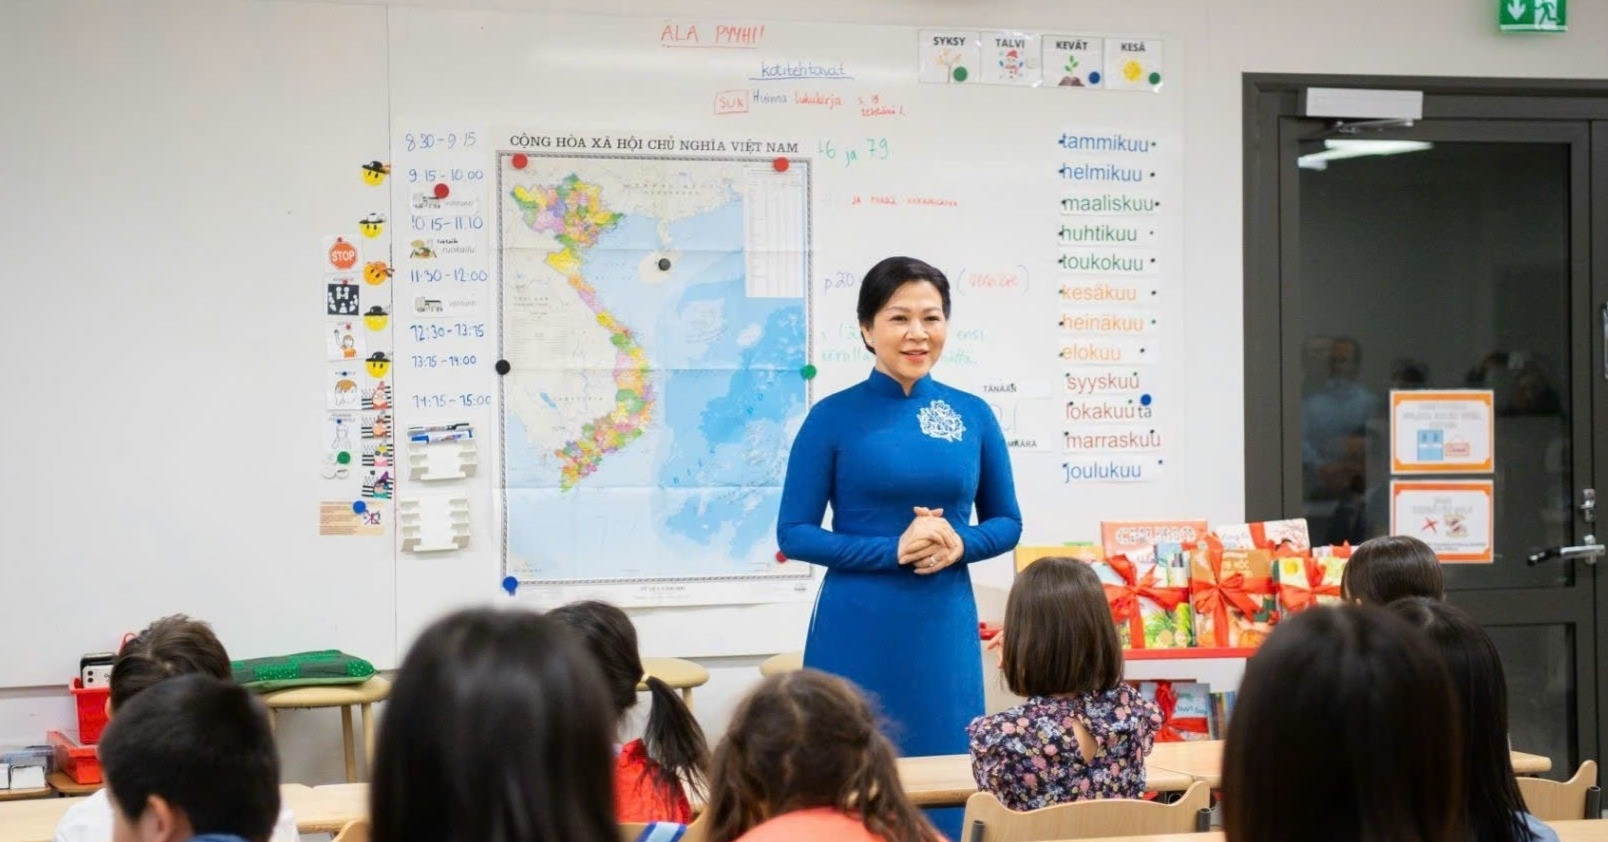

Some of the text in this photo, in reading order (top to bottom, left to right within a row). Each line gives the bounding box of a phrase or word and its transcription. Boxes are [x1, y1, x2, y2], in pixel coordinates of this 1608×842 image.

[933, 36, 966, 46] SYKSY
[995, 38, 1025, 48] TALVI
[1056, 39, 1088, 50] KEVÄT
[1121, 41, 1146, 52] KESÄ
[510, 132, 551, 149] CỘNG
[617, 135, 643, 152] HỘI
[647, 135, 675, 151] CHỦ
[680, 138, 727, 152] NGHĨA
[731, 138, 763, 155] VIỆT
[766, 142, 799, 154] NAM
[1062, 133, 1149, 152] tammikuu
[1062, 163, 1142, 181] helmikuu
[1064, 194, 1153, 211] maaliskuu
[1061, 225, 1137, 241] huhtikuu
[331, 249, 355, 262] STOP
[1062, 253, 1143, 271] toukokuu
[1062, 283, 1137, 301] kesäkuu
[1062, 313, 1143, 331] heinäkuu
[1062, 343, 1121, 360] elokuu
[1067, 373, 1140, 394] syyskuu
[1066, 431, 1161, 449] marraskuu
[1065, 462, 1141, 483] joulukuu
